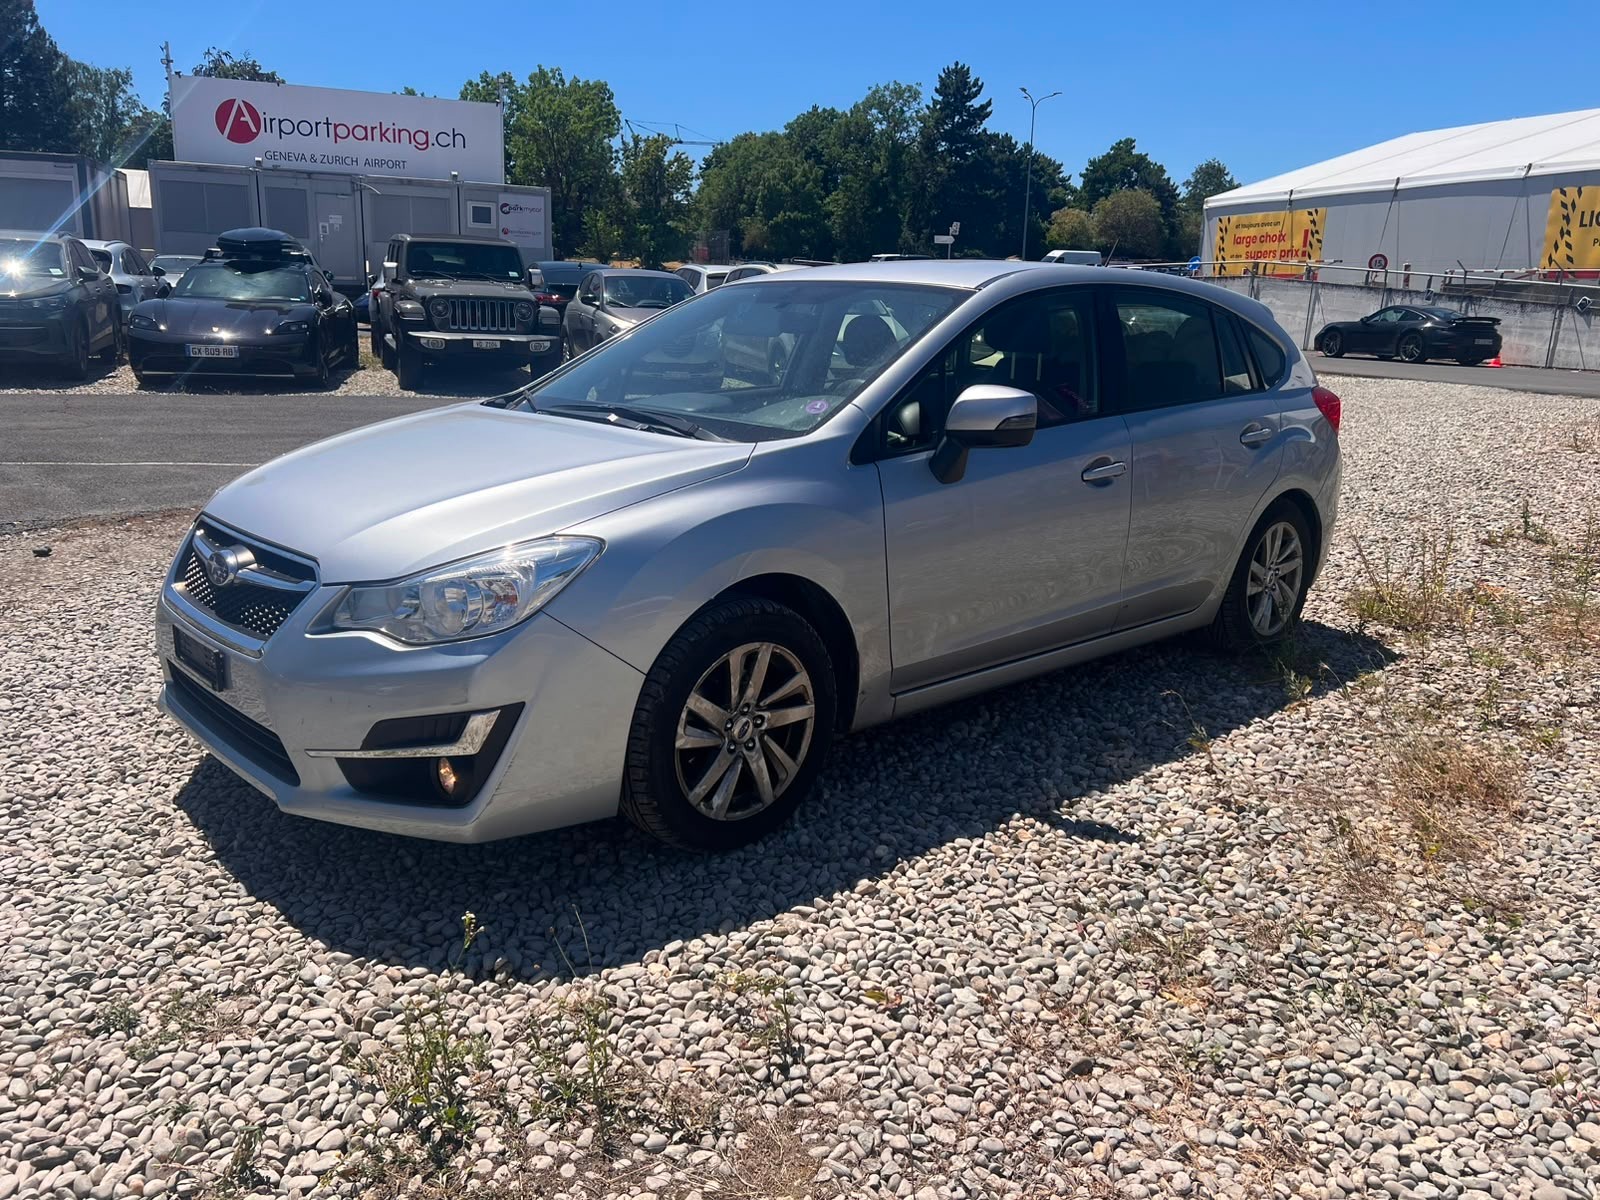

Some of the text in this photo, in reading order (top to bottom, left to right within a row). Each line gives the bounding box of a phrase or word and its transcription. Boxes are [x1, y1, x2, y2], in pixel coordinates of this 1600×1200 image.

[216, 99, 467, 150] Airportparking.ch
[264, 150, 407, 170] GENEVA & ZURICH AIRPORT
[1241, 222, 1260, 230] toujours
[1233, 230, 1286, 248] large choix
[1245, 249, 1277, 261] supers
[1279, 245, 1300, 260] prix
[1374, 259, 1383, 267] 15
